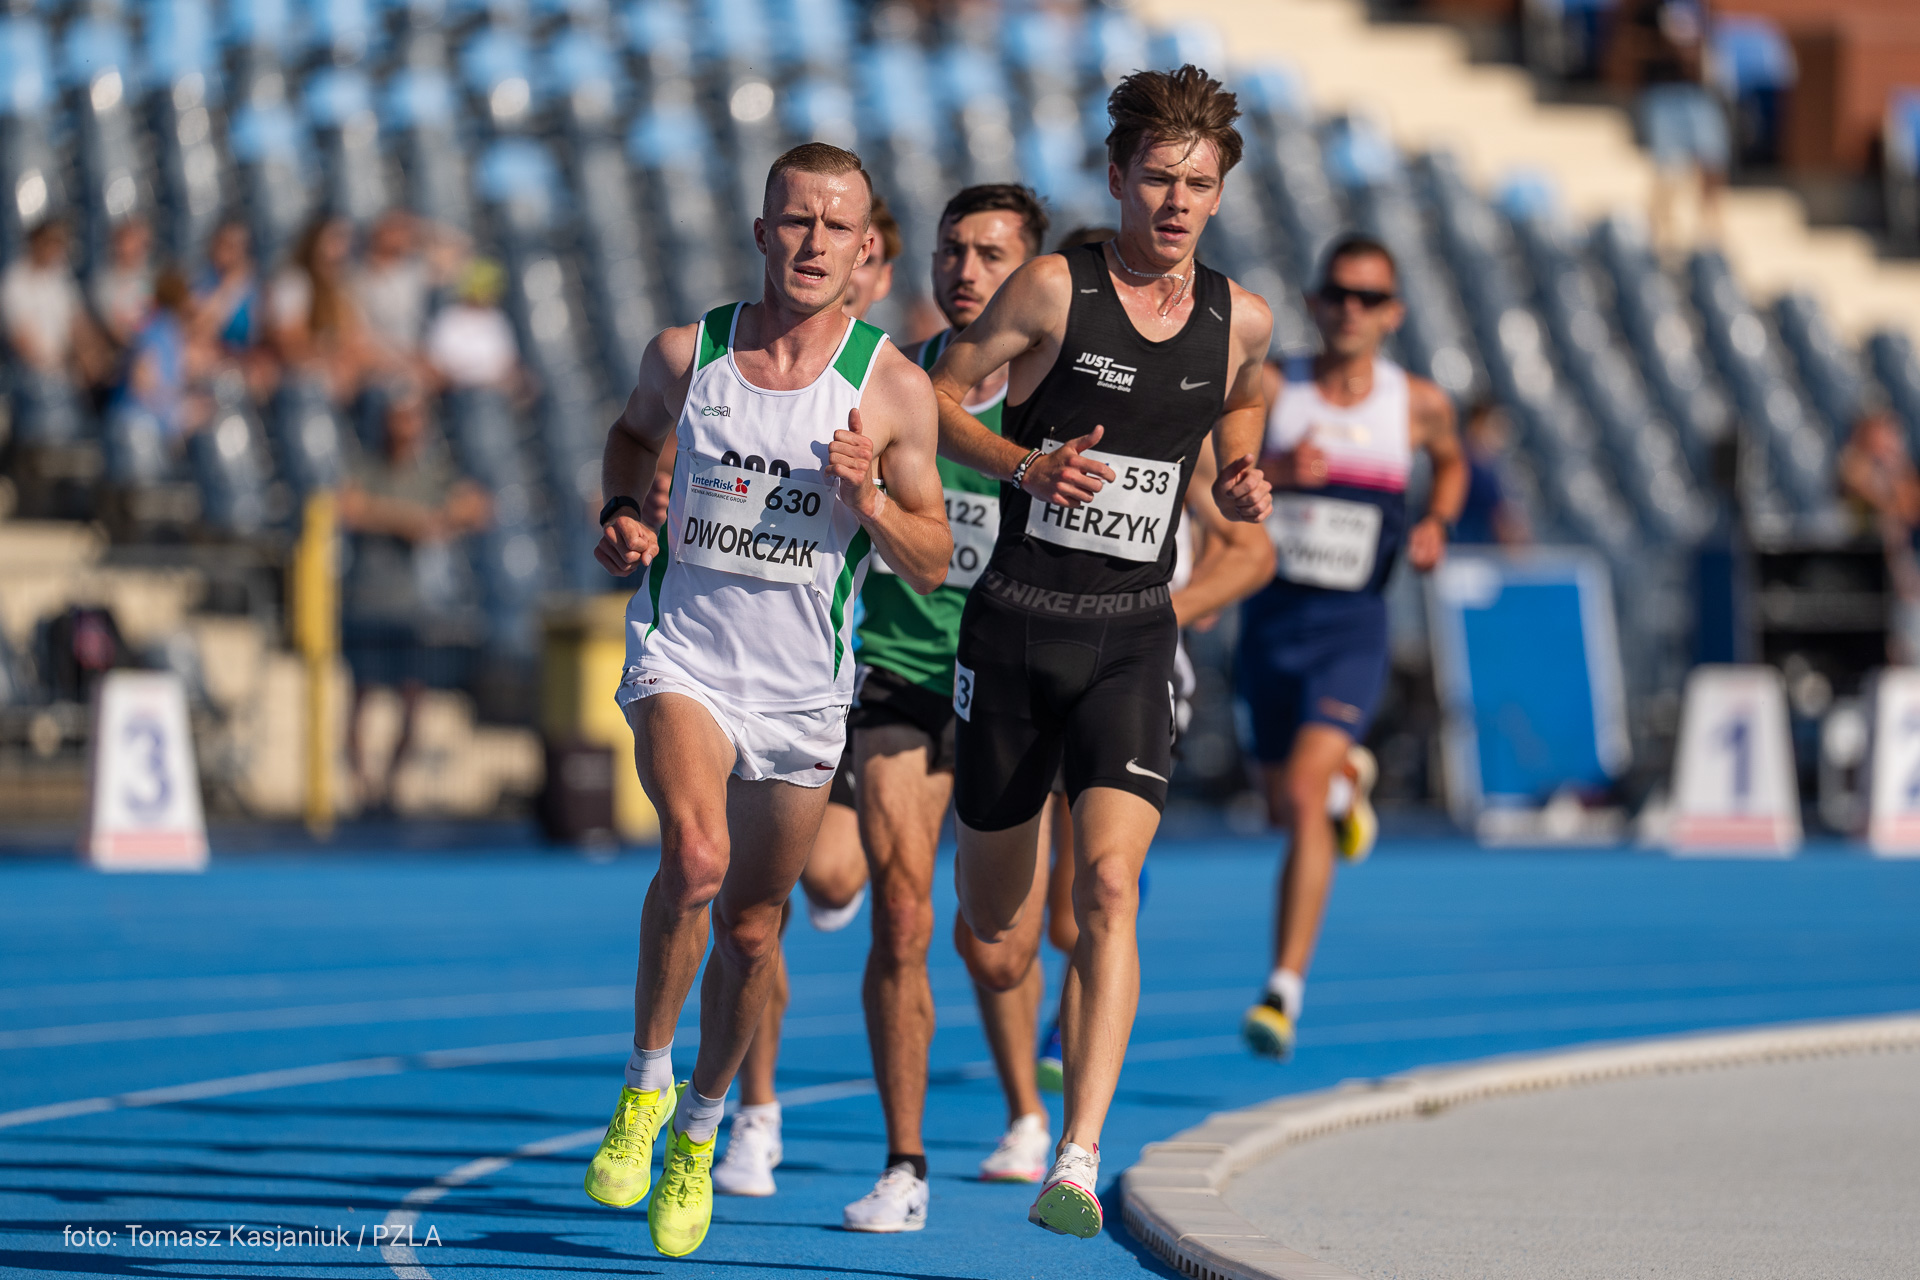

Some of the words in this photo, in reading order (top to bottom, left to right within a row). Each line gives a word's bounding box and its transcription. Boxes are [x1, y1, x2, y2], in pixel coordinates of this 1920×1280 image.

[1076, 352, 1114, 369] JUST
[1098, 368, 1135, 387] TEAM
[692, 473, 734, 492] InterRisk
[1121, 466, 1170, 495] 533
[765, 486, 821, 516] 630
[1042, 500, 1160, 544] HERZYK
[684, 516, 819, 568] DWORCZAK
[1001, 581, 1074, 613] NIKE
[1075, 594, 1135, 615] PRO
[958, 674, 971, 710] 3
[123, 712, 174, 826] 3
[1708, 712, 1755, 812] 1
